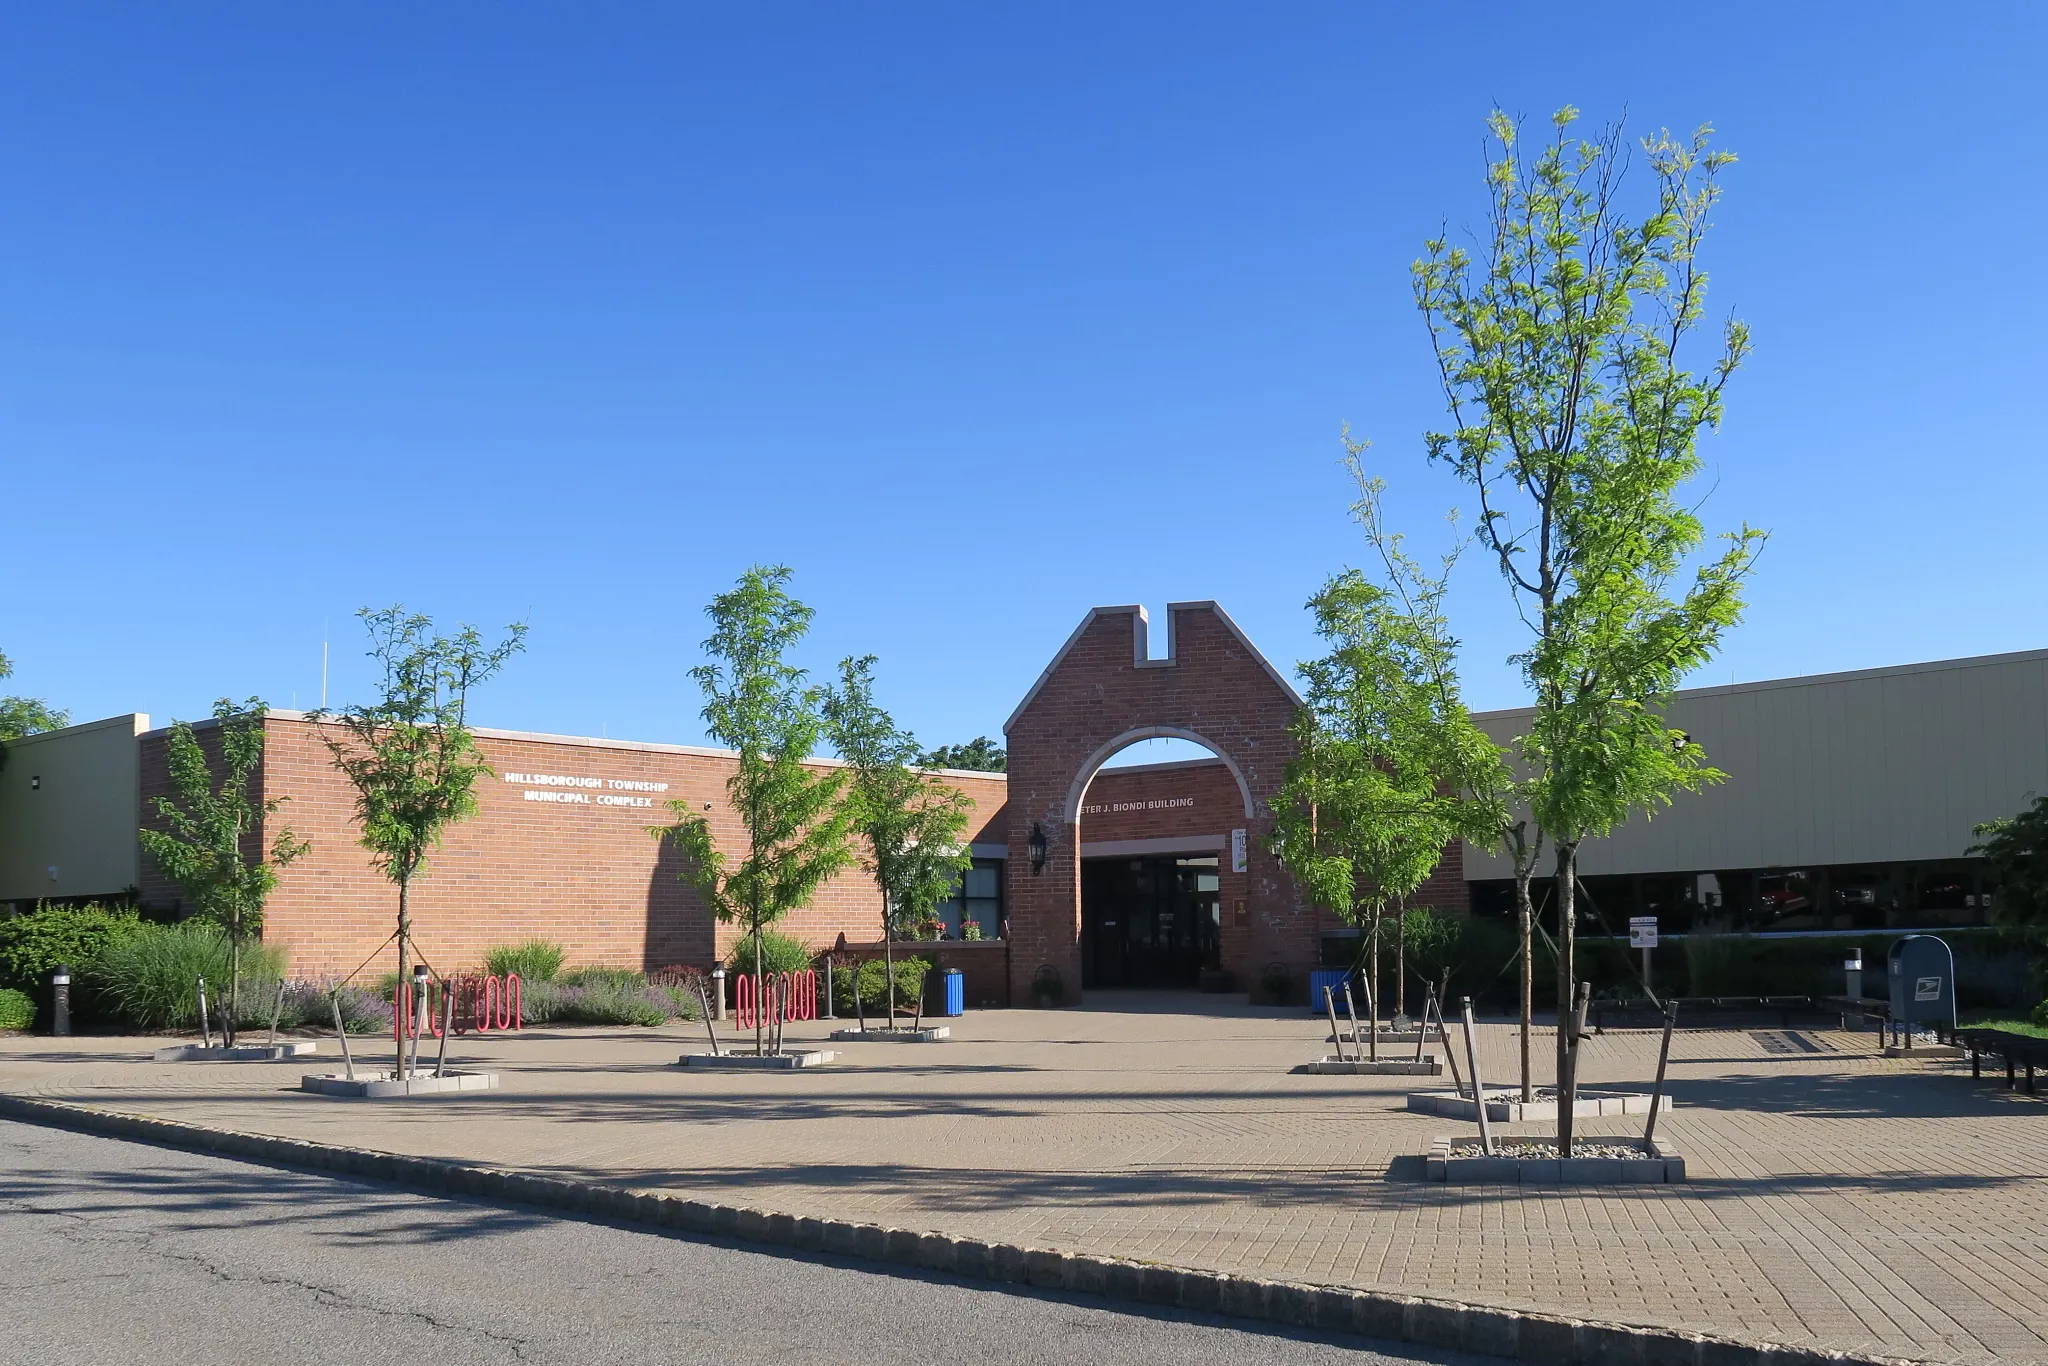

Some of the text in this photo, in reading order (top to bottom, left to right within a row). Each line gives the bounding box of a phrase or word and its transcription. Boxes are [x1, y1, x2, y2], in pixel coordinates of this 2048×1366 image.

[504, 772, 669, 792] HILLSBOROUGH TOWNSHIP
[524, 790, 652, 808] MUNICIPAL COMPLEX
[1080, 797, 1194, 814] ETER J. BIONDI BUILDING
